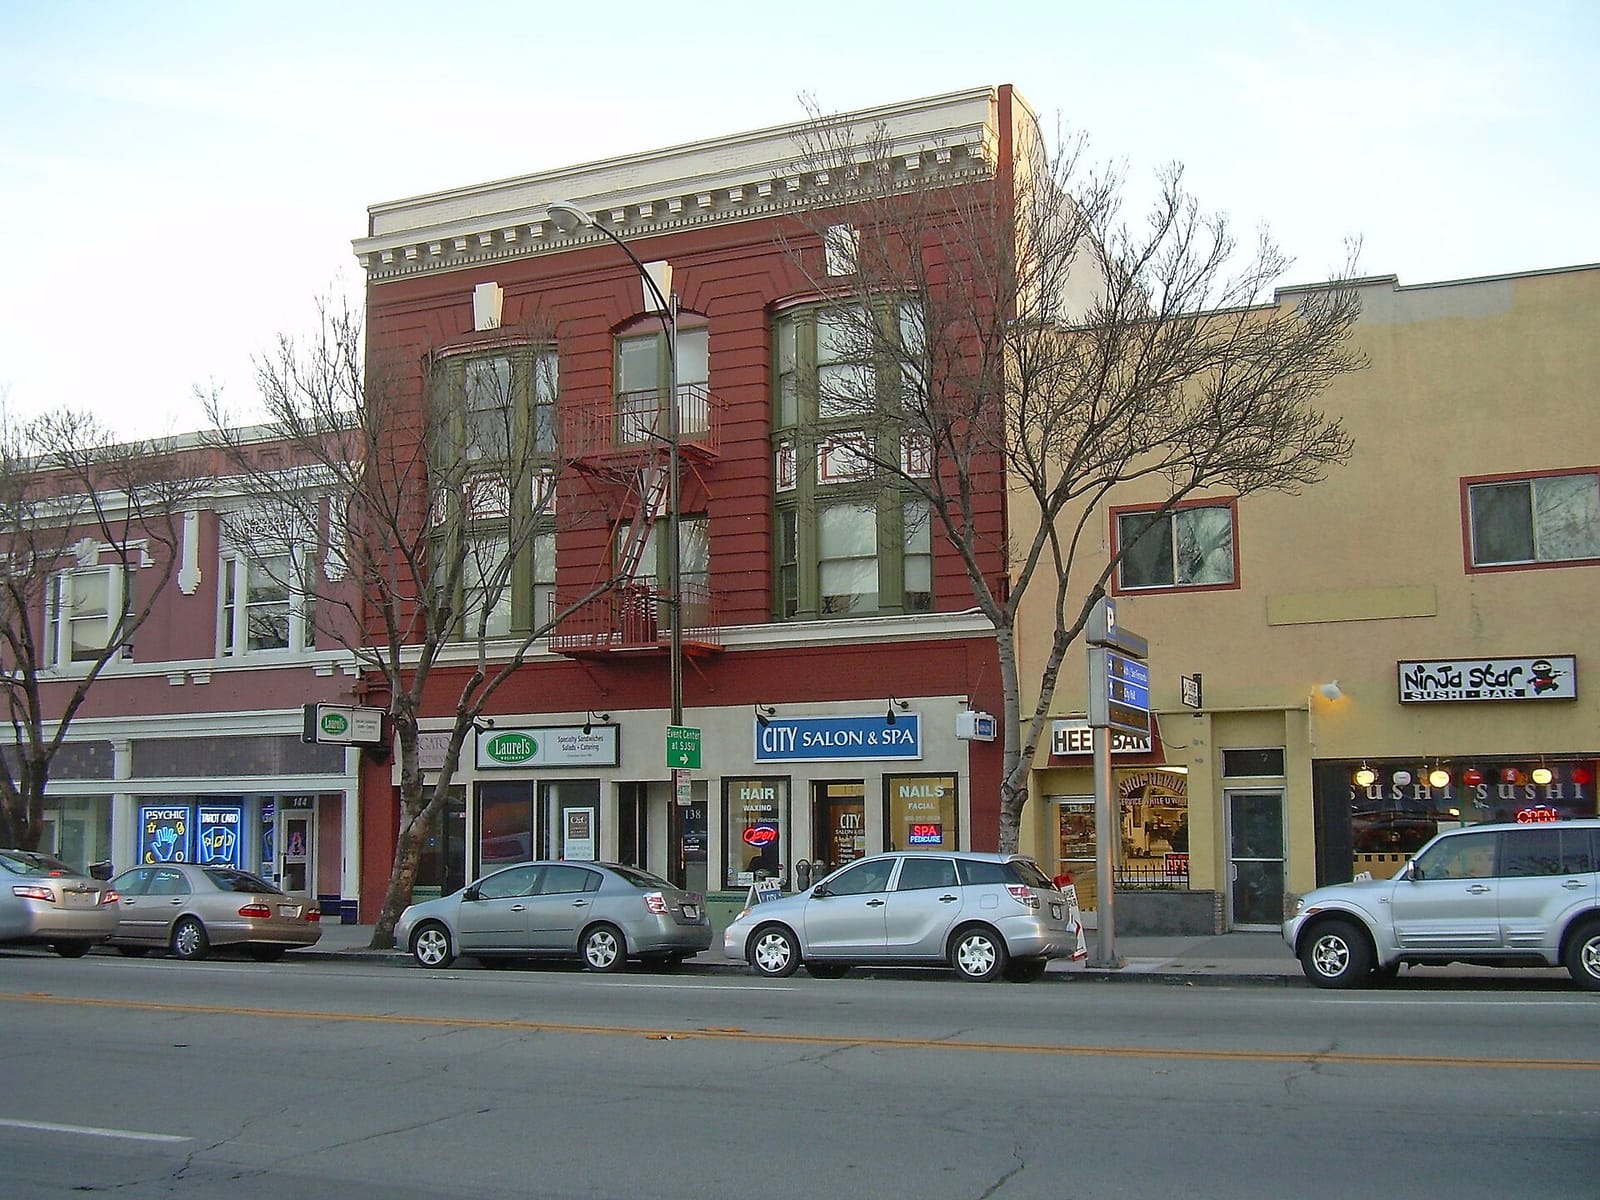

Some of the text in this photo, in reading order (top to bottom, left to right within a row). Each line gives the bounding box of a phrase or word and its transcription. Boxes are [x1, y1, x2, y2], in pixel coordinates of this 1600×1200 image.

[1107, 606, 1115, 633] P
[1408, 689, 1519, 700] SUSHI BAR
[667, 728, 701, 740] Event Center
[762, 727, 915, 752] CITY SALON & SPA
[495, 738, 531, 755] Laurel's
[671, 741, 696, 751] at SJSU
[740, 788, 775, 800] HAIR
[899, 786, 945, 798] NAILS
[1349, 782, 1584, 800] SUSHI SUSHI
[743, 804, 772, 812] WAXING
[908, 803, 936, 811] FACIAL
[145, 811, 185, 820] PSYCHIC
[221, 813, 239, 824] CARD
[685, 809, 701, 820] 138
[840, 814, 861, 829] CITY
[743, 828, 777, 843] Open
[914, 825, 937, 836] SPA
[910, 835, 941, 843] PEDICURE
[1166, 859, 1189, 876] OPE
